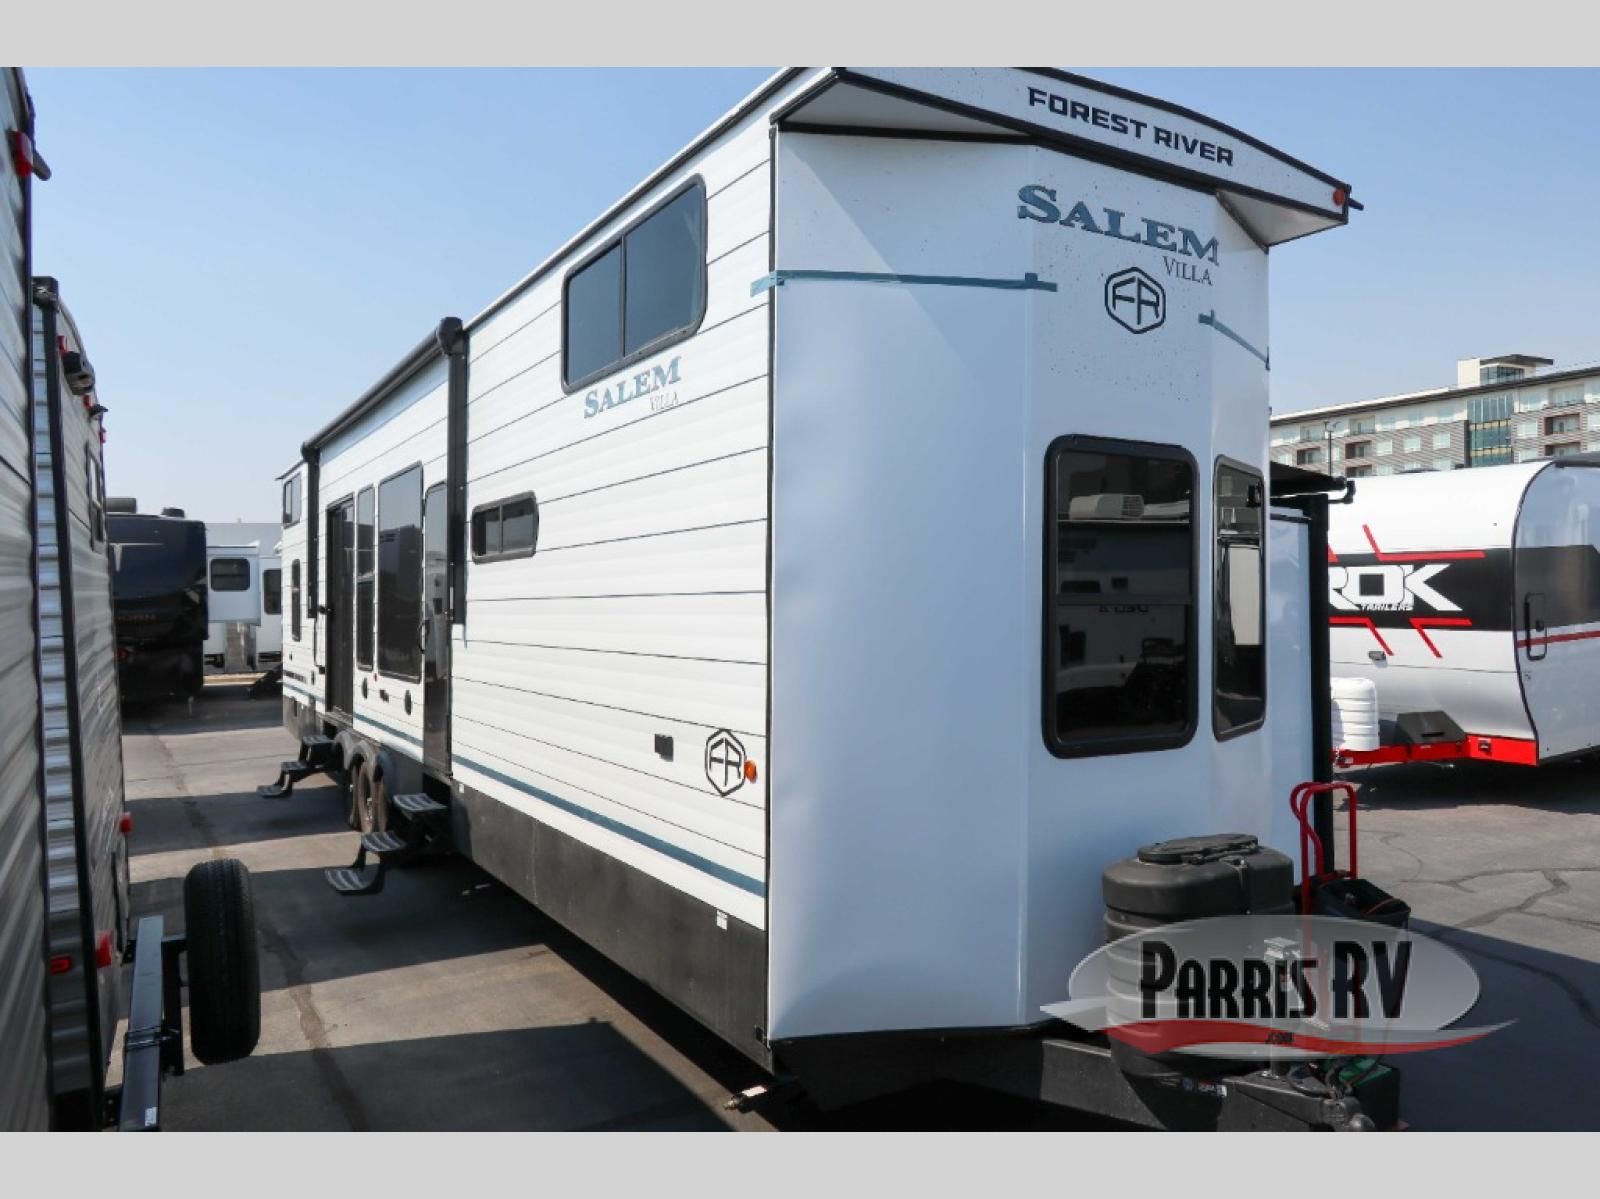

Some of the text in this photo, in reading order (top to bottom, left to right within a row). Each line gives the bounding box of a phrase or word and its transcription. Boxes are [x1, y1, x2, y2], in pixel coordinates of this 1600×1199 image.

[1028, 87, 1233, 166] FOREST RIVER
[1018, 185, 1219, 266] SALEM
[1163, 255, 1214, 286] VILLA
[583, 356, 681, 419] SALEM
